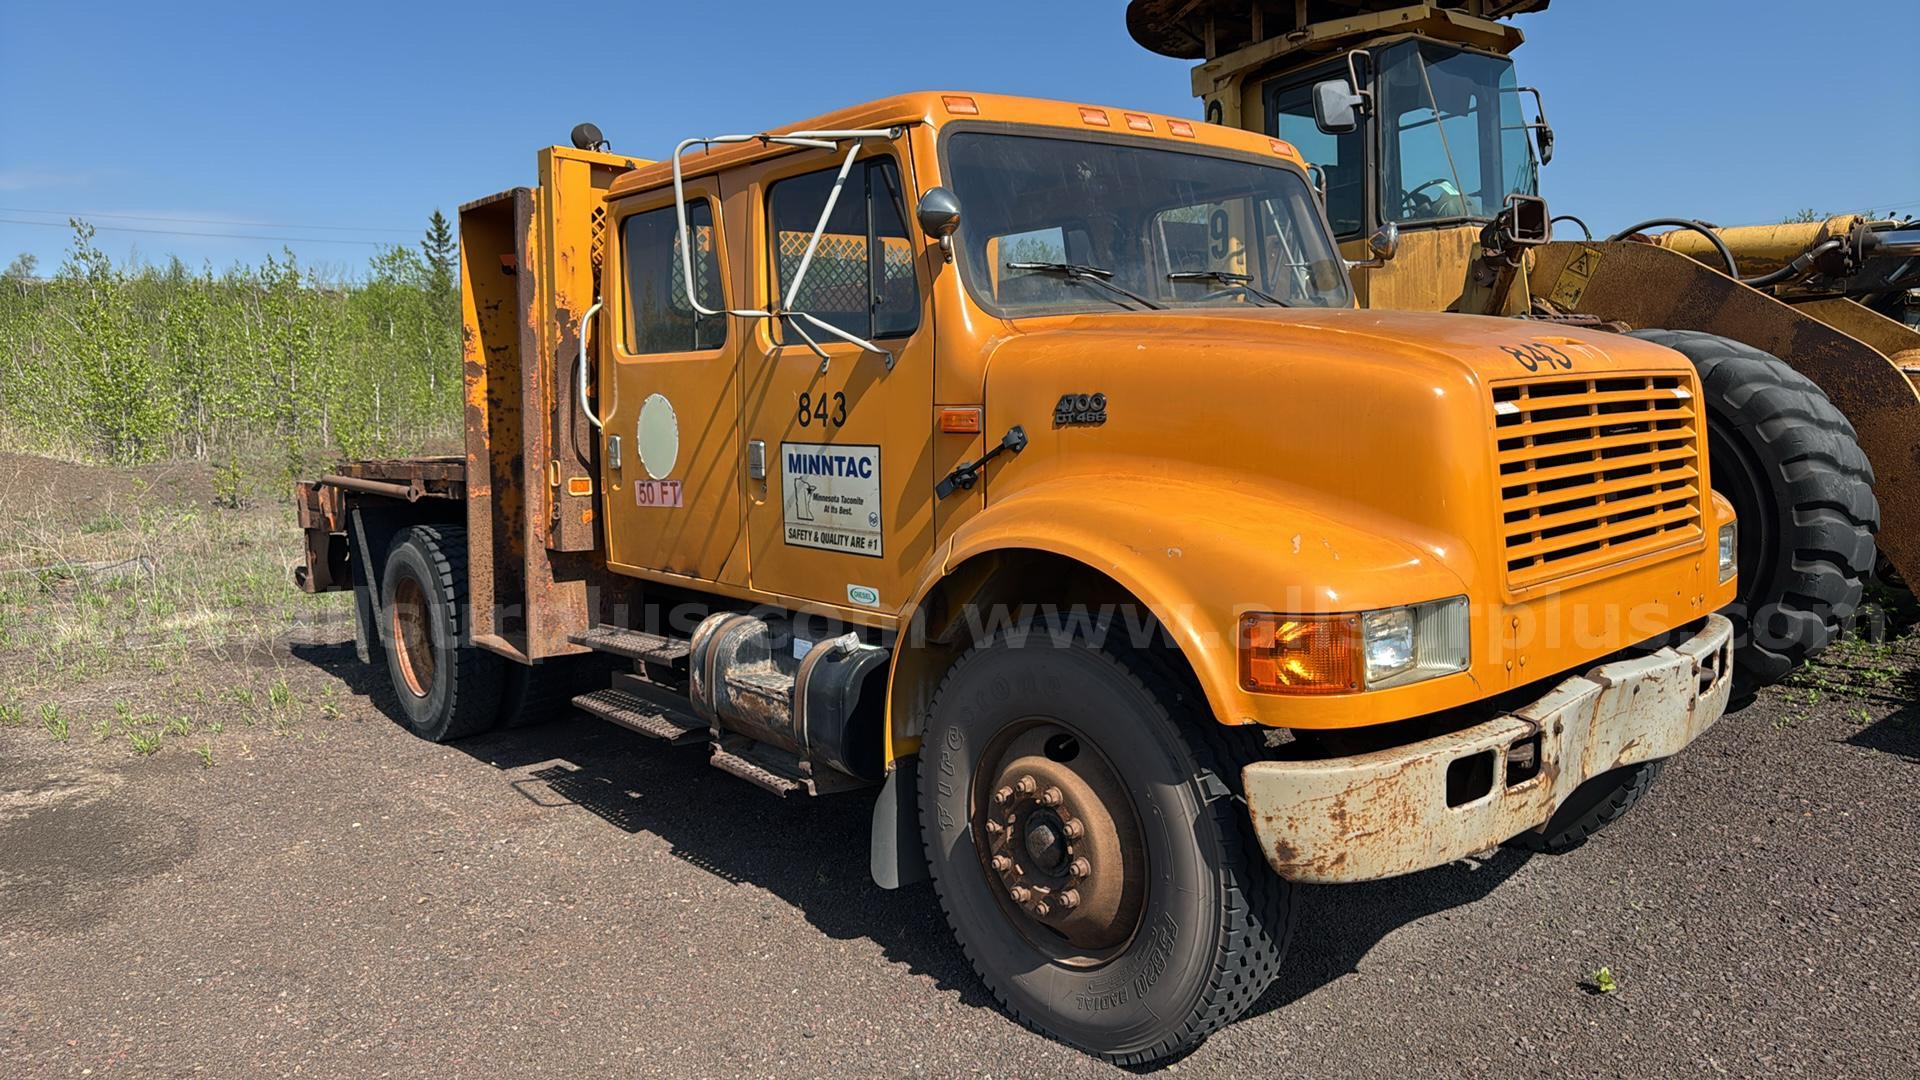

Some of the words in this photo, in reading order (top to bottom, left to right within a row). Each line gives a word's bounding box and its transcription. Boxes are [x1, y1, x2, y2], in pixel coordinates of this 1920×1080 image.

[1499, 343, 1572, 372] 843
[798, 391, 847, 428] 843
[788, 453, 873, 479] MINNTAC
[639, 482, 655, 505] 50
[660, 481, 679, 505] FT
[812, 493, 840, 504] Minnesota
[841, 495, 864, 506] Taconite
[823, 504, 831, 513] At
[788, 527, 813, 542] SAFETY
[814, 531, 819, 543] &
[820, 532, 850, 547] QUALITY
[850, 535, 866, 549] ARE
[867, 538, 878, 551] #1
